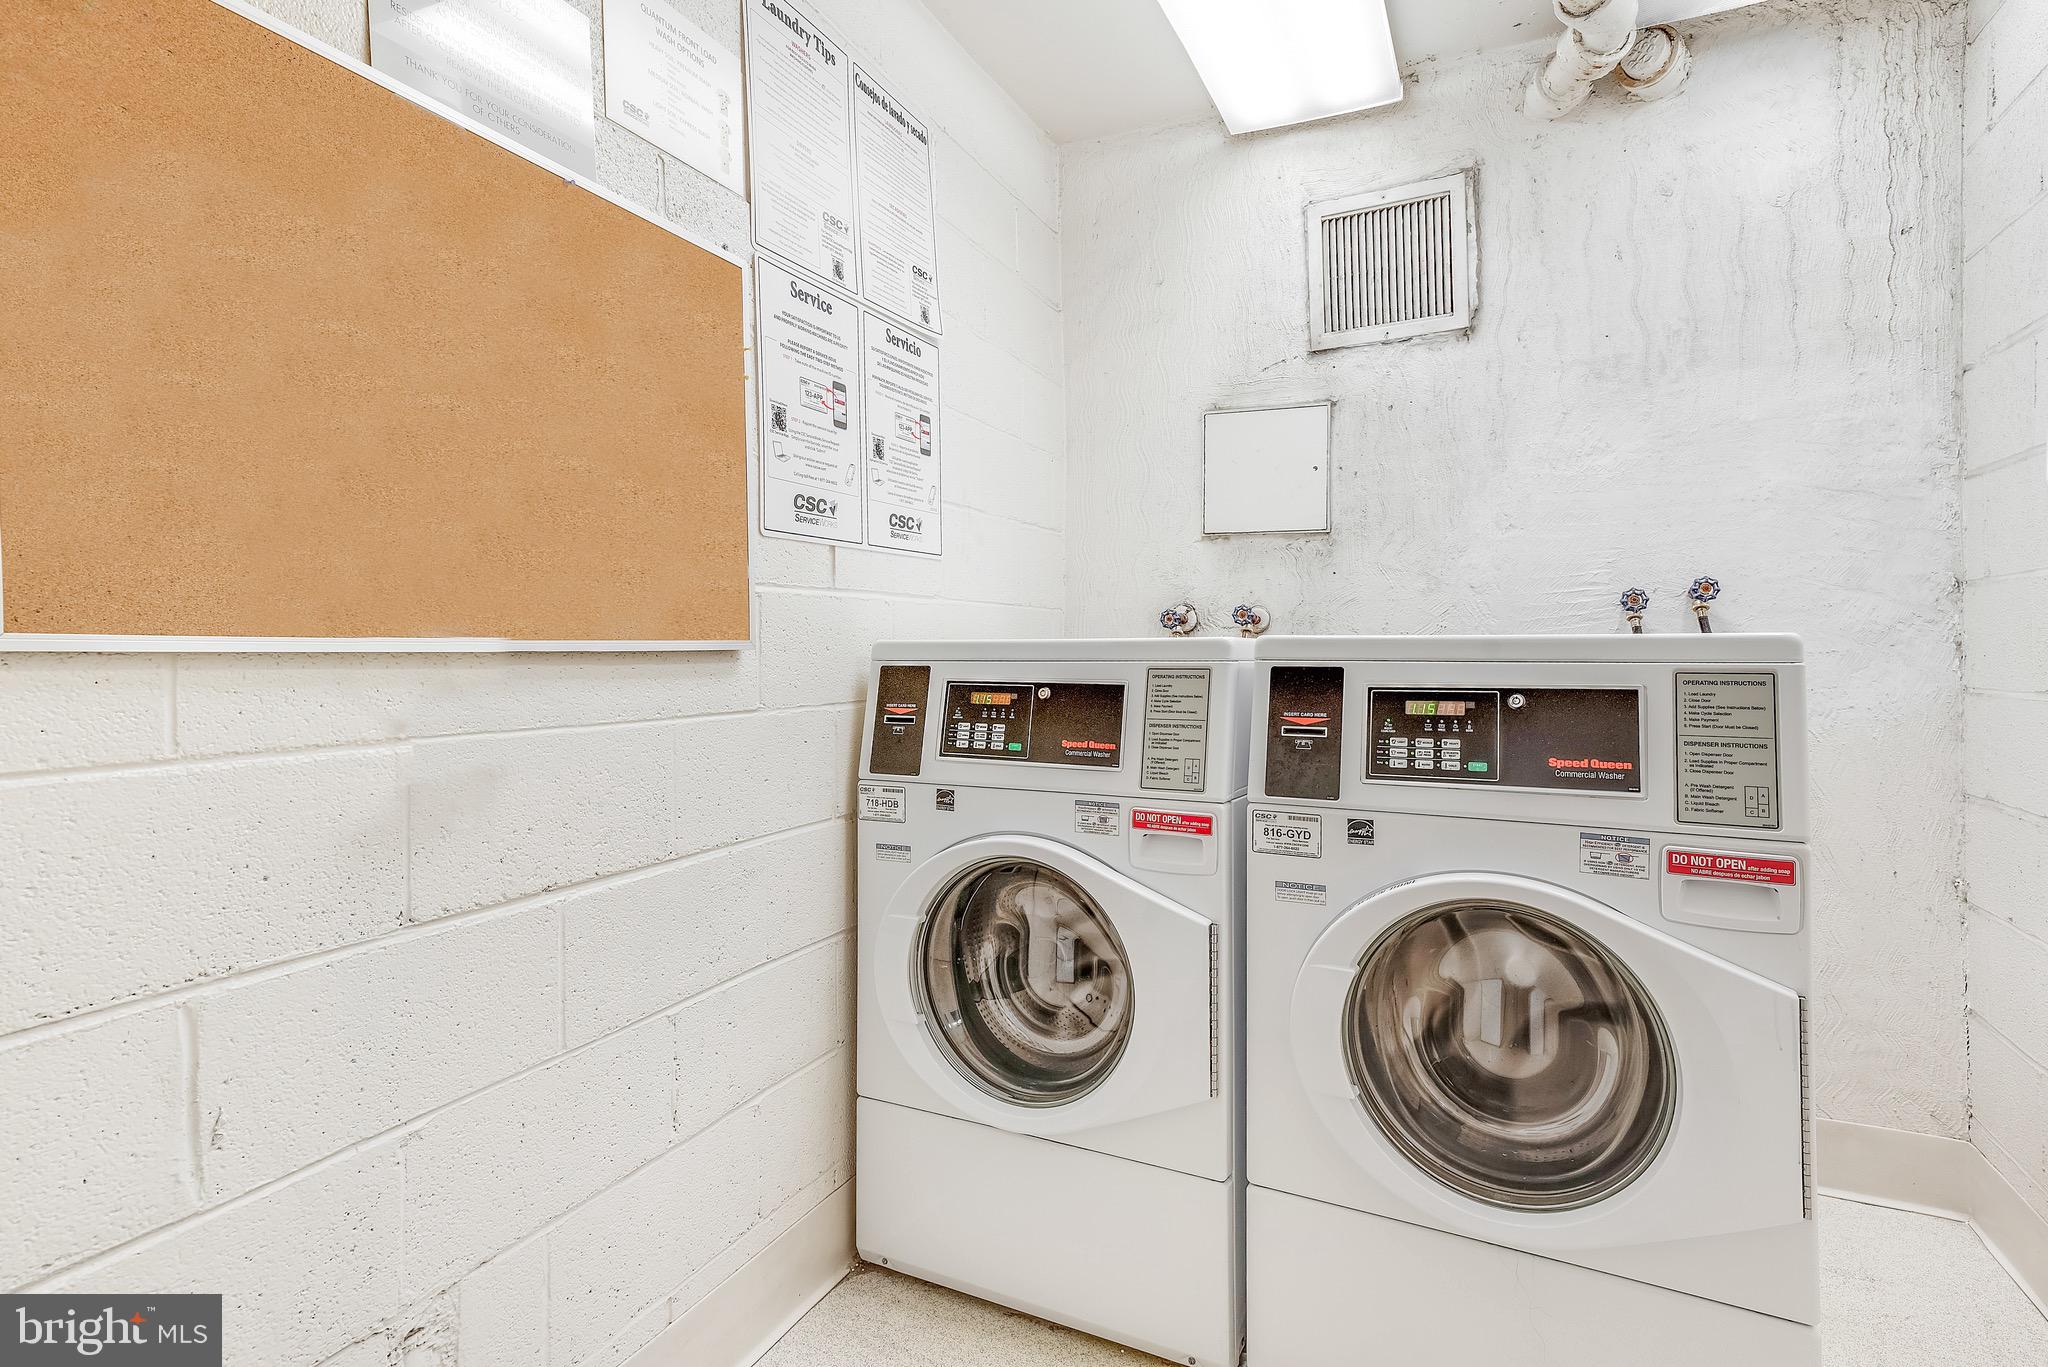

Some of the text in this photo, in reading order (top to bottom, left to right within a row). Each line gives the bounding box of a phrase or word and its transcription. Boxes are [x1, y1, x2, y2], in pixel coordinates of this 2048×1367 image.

[640, 3, 717, 65] QUANTUM FRONT LOAD
[656, 26, 705, 68] WASH OPTIONS
[813, 34, 836, 66] Tips
[404, 56, 576, 153] THANK YOU FOR YOUR CONSIDERATION
[855, 72, 881, 105] Consejos
[881, 96, 889, 111] de
[910, 124, 927, 145] secado
[472, 104, 521, 136] OF OTHERS
[822, 211, 843, 230] CSC
[911, 265, 928, 280] CSC
[790, 280, 833, 315] Service
[885, 327, 921, 357] Servicio
[793, 494, 828, 514] CSC
[889, 514, 915, 531] CSC
[1062, 740, 1116, 750] Speed Queen
[1065, 750, 1111, 758] Commercial Washer
[1548, 758, 1632, 770] Speed Queen
[1555, 770, 1625, 780] Commercial Washer
[866, 799, 899, 808] 718-HDB
[1147, 814, 1160, 822] NOT
[1162, 815, 1182, 824] OPEN
[1264, 827, 1311, 840] 816-GYD
[1672, 854, 1688, 864] DO
[1691, 855, 1713, 866] NOT
[1716, 857, 1746, 870] OPEN
